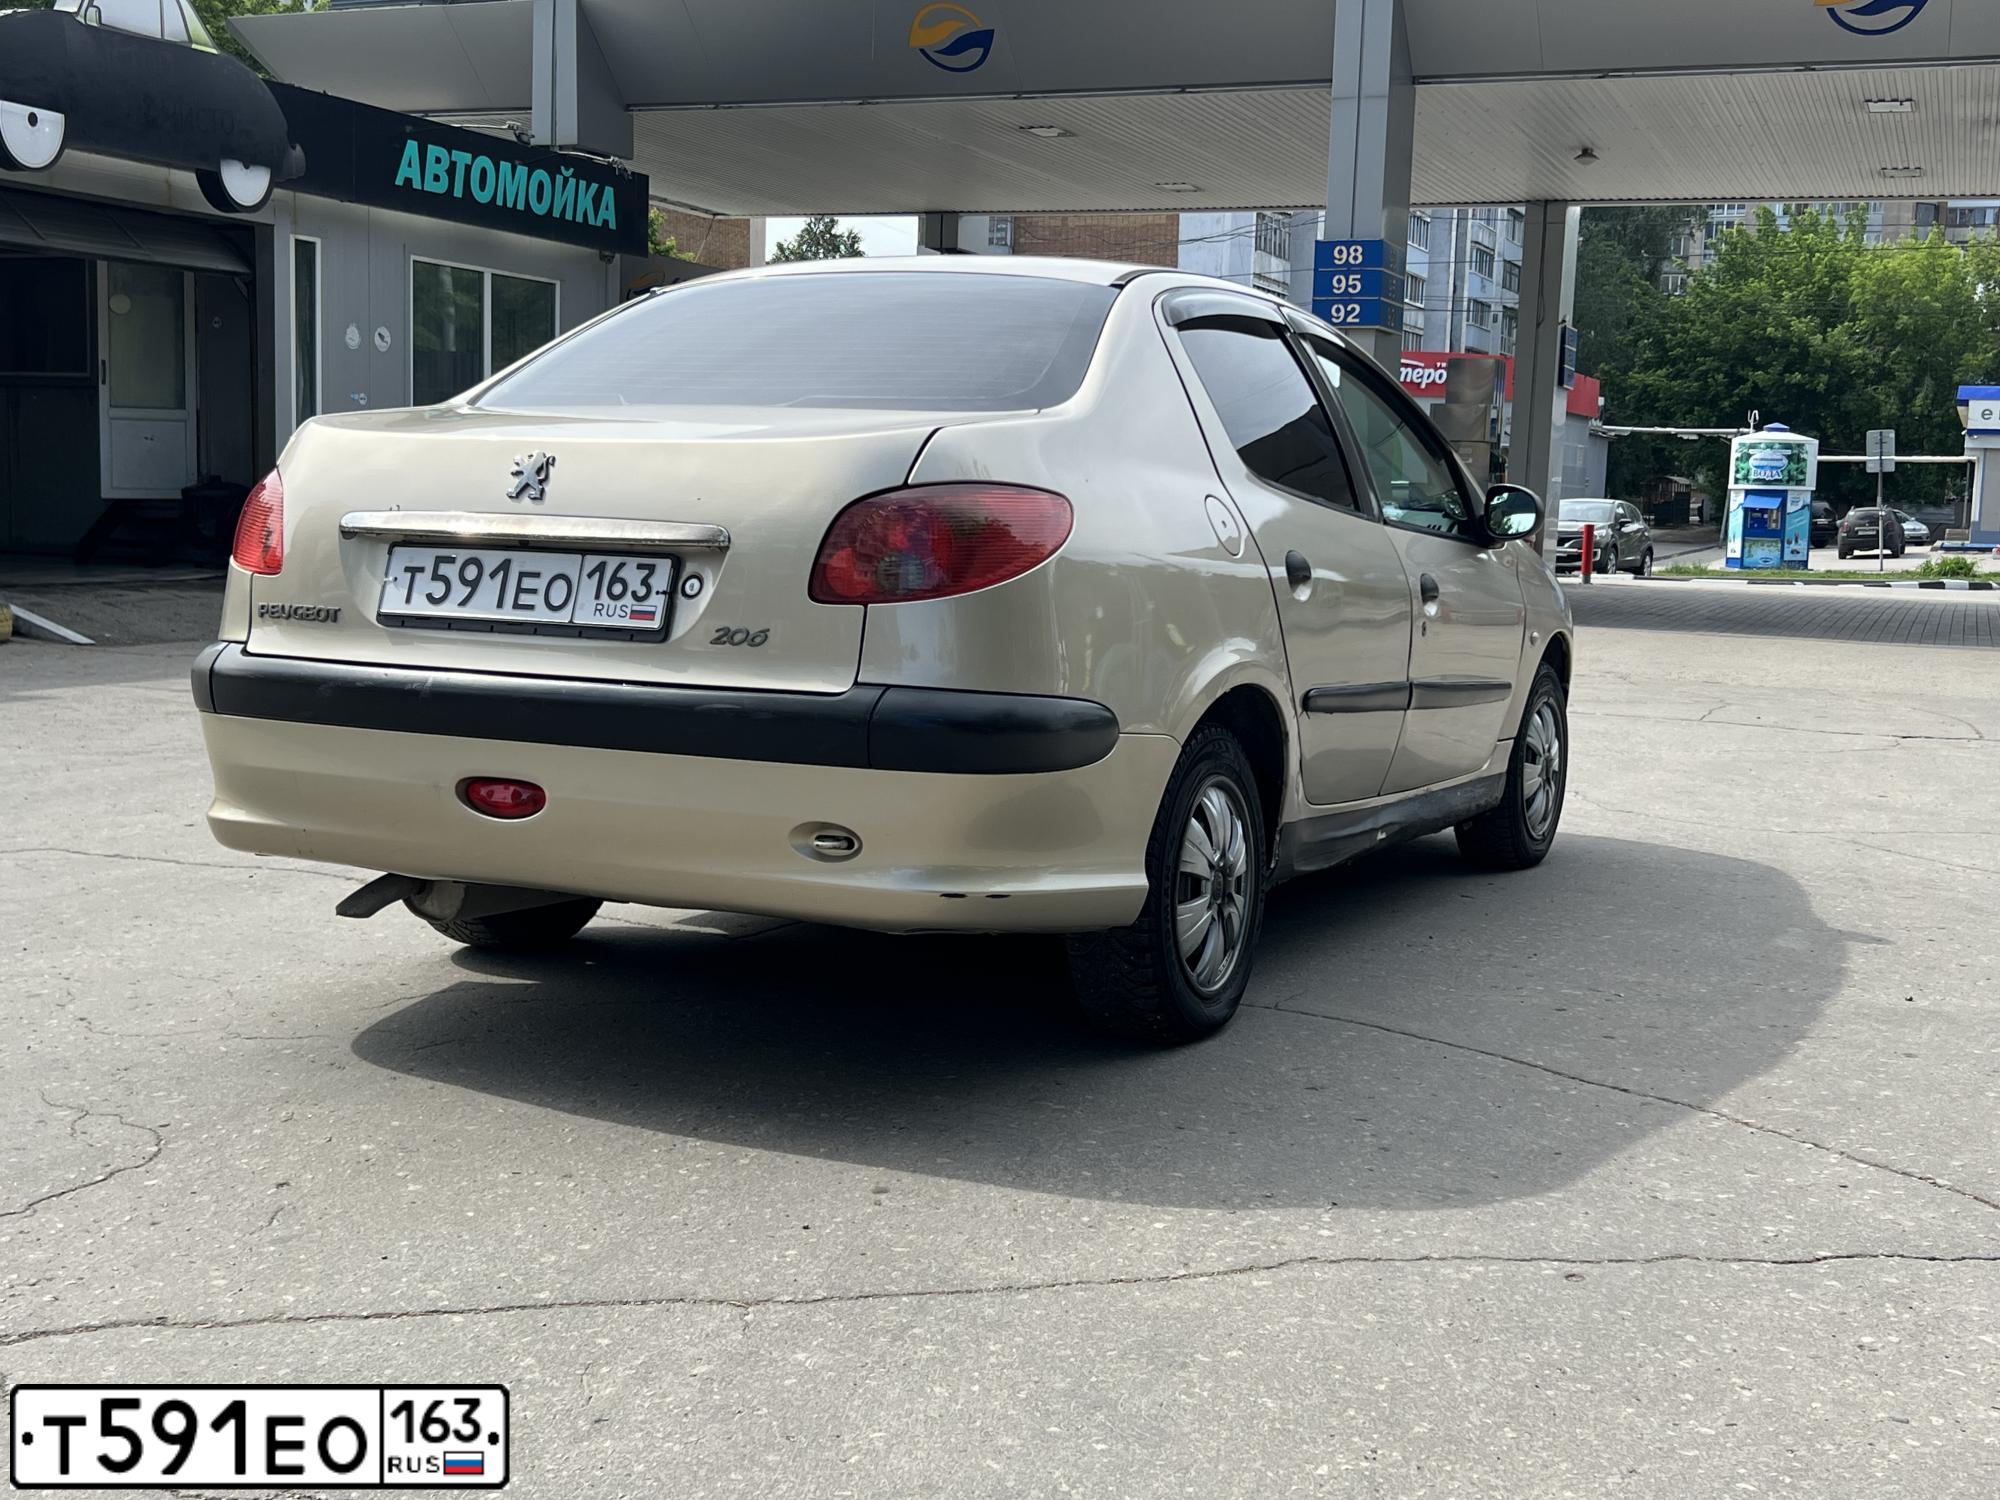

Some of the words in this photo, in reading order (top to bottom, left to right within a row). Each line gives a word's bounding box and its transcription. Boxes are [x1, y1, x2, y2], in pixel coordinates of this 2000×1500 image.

[394, 139, 617, 230] АВТОМОЙКА
[1333, 245, 1363, 265] 98
[1332, 274, 1362, 294] 95
[1331, 303, 1361, 323] 92
[403, 555, 573, 612] Т591ЕО
[587, 560, 657, 602] 163
[258, 603, 342, 623] PEUGEOT
[594, 602, 629, 619] RUS
[709, 626, 770, 648] 206
